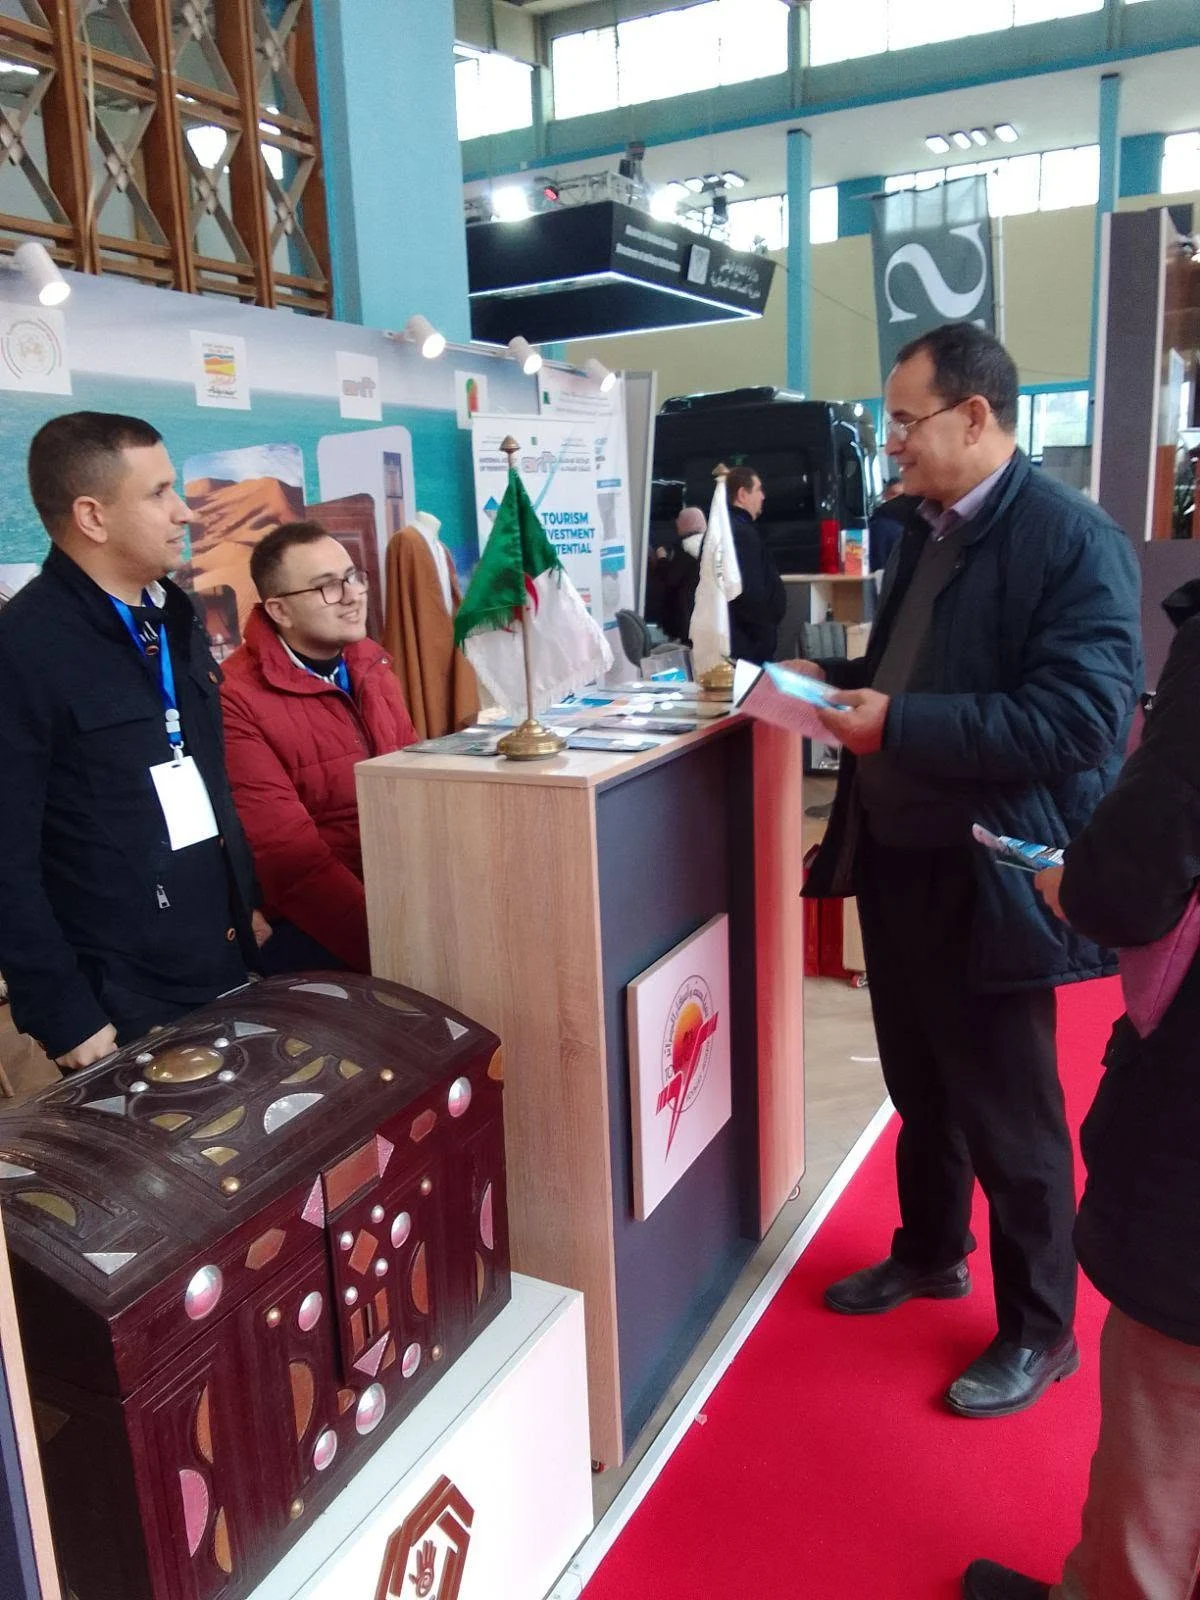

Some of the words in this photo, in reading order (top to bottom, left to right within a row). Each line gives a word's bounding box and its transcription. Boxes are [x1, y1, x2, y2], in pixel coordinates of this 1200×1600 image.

[541, 511, 588, 525] TOURISM
[546, 527, 595, 540] VESTMENT
[554, 543, 592, 555] TENTIAL
